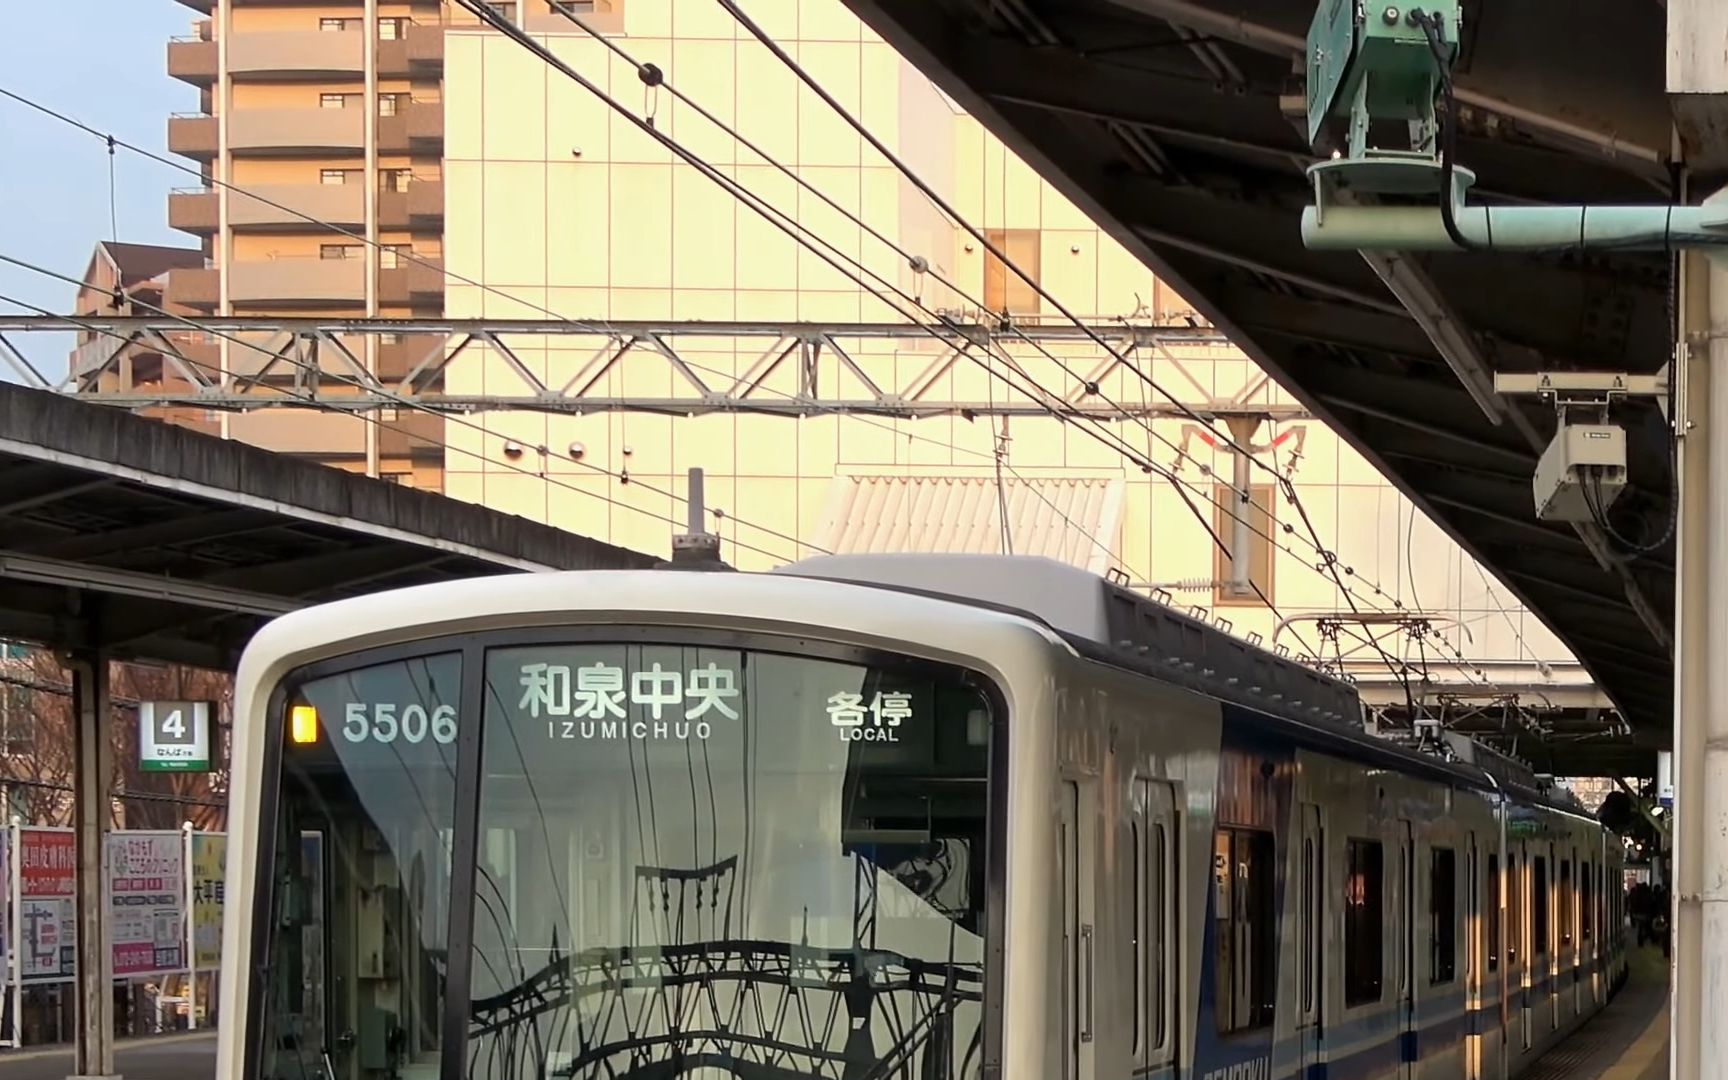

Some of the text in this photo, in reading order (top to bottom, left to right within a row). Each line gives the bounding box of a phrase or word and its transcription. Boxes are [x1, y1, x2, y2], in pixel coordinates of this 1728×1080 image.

[518, 661, 740, 721] 和泉中央
[161, 709, 187, 739] 4
[342, 702, 458, 744] 5506
[826, 691, 913, 727] 各停
[548, 721, 712, 740] IZUMICHUO
[840, 727, 900, 742] LOCAL
